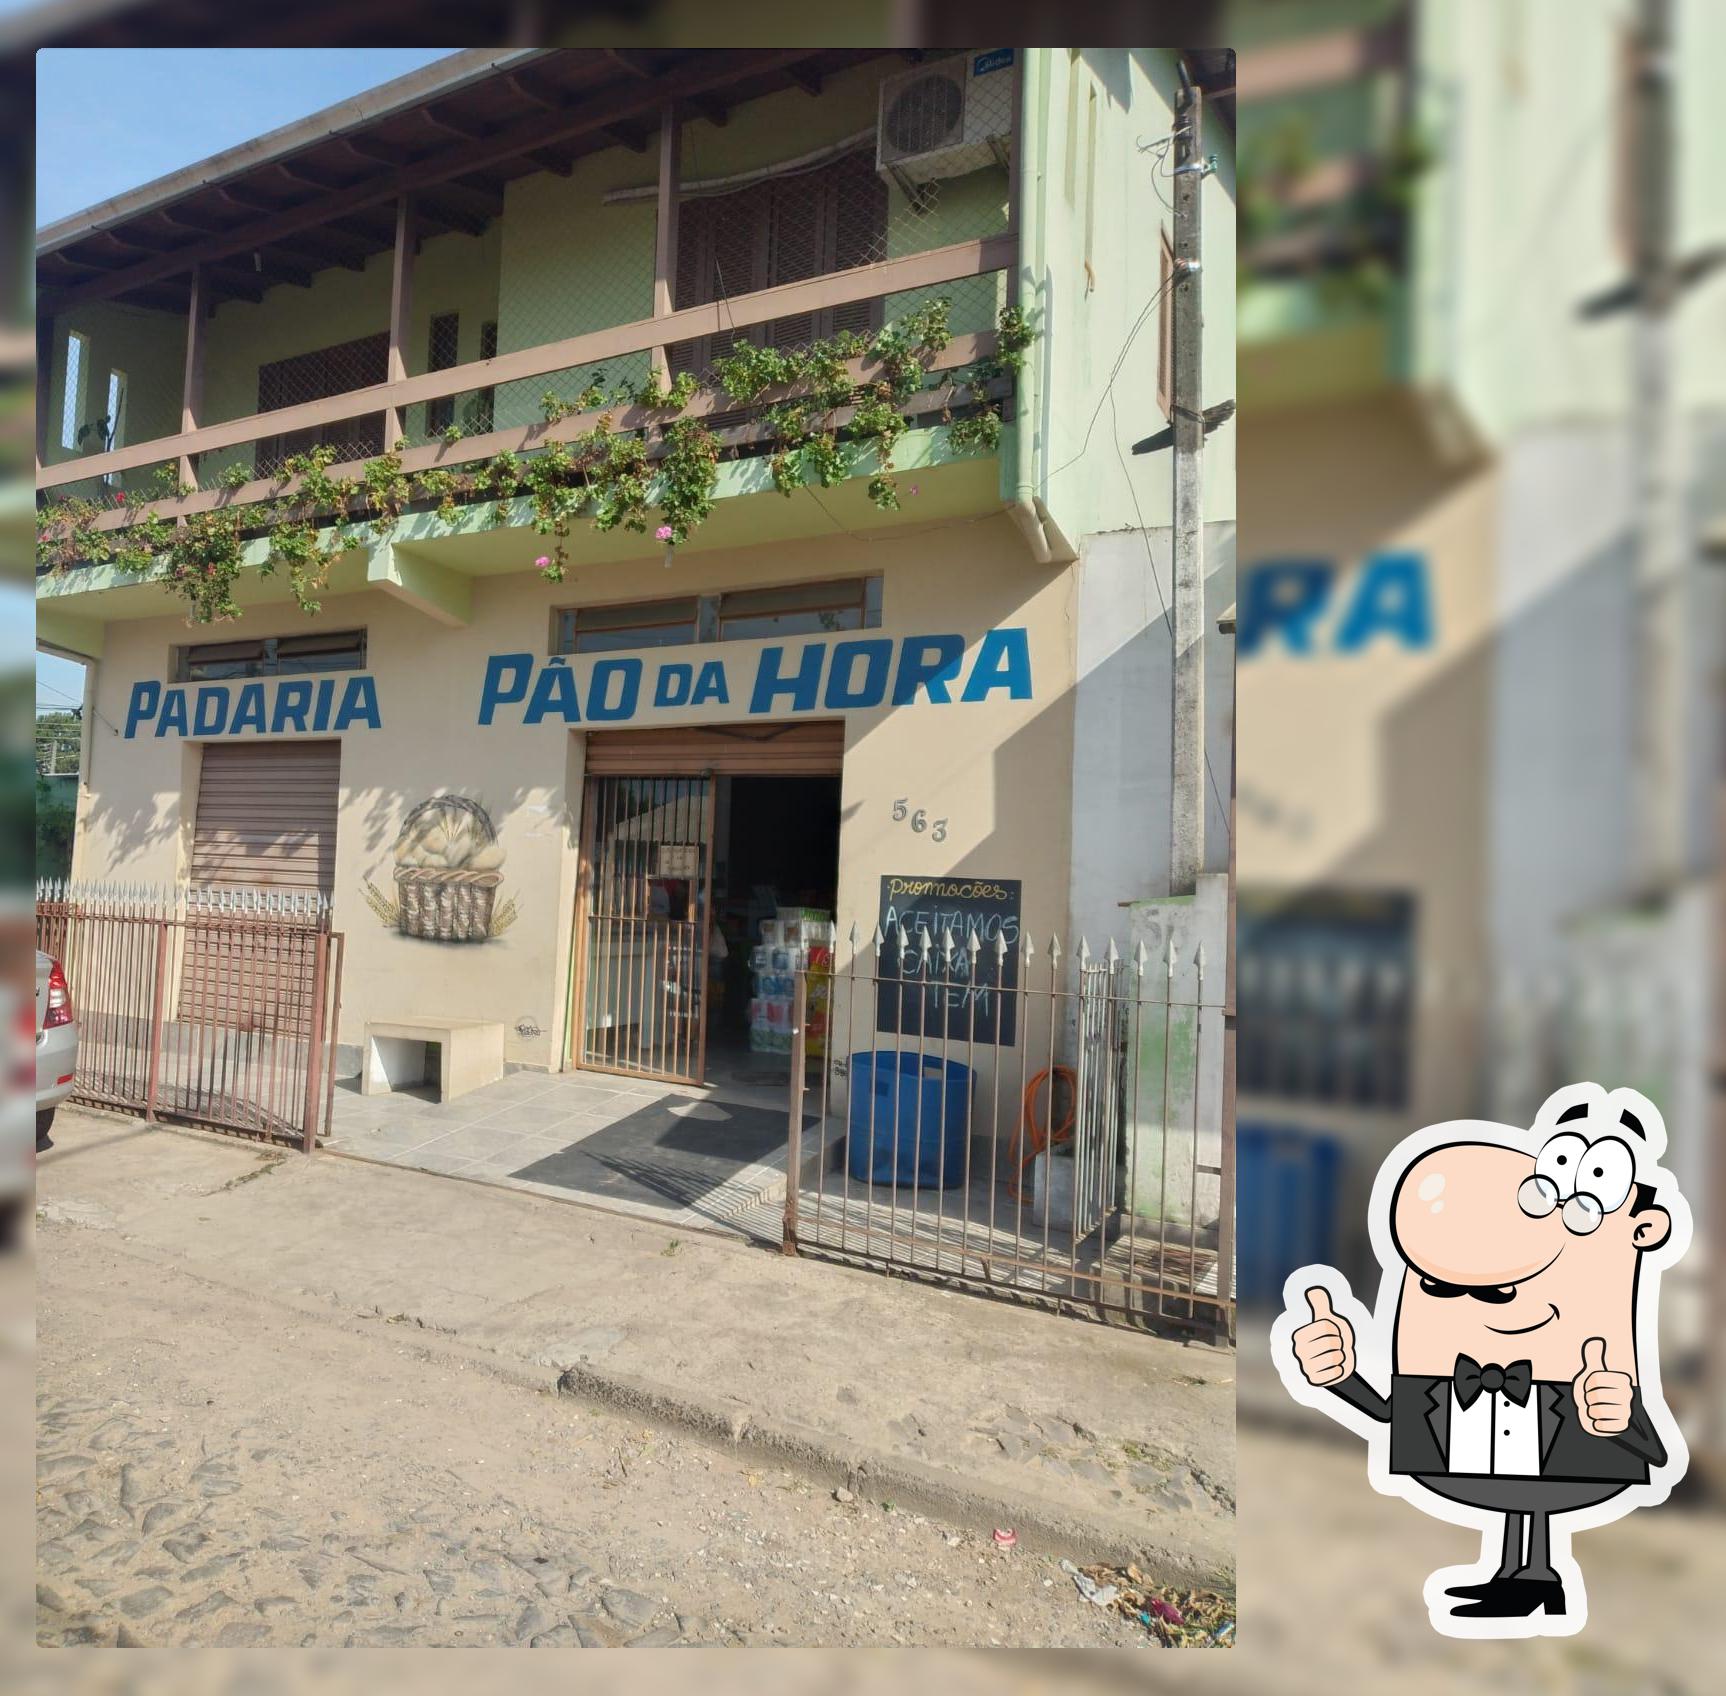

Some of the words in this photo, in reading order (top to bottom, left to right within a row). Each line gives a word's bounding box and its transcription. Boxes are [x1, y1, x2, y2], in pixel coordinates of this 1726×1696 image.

[124, 676, 382, 739] PADARIA
[478, 653, 643, 725] PÃO
[653, 661, 730, 707] DA
[749, 627, 1033, 713] HORA
[892, 798, 949, 842] 563
